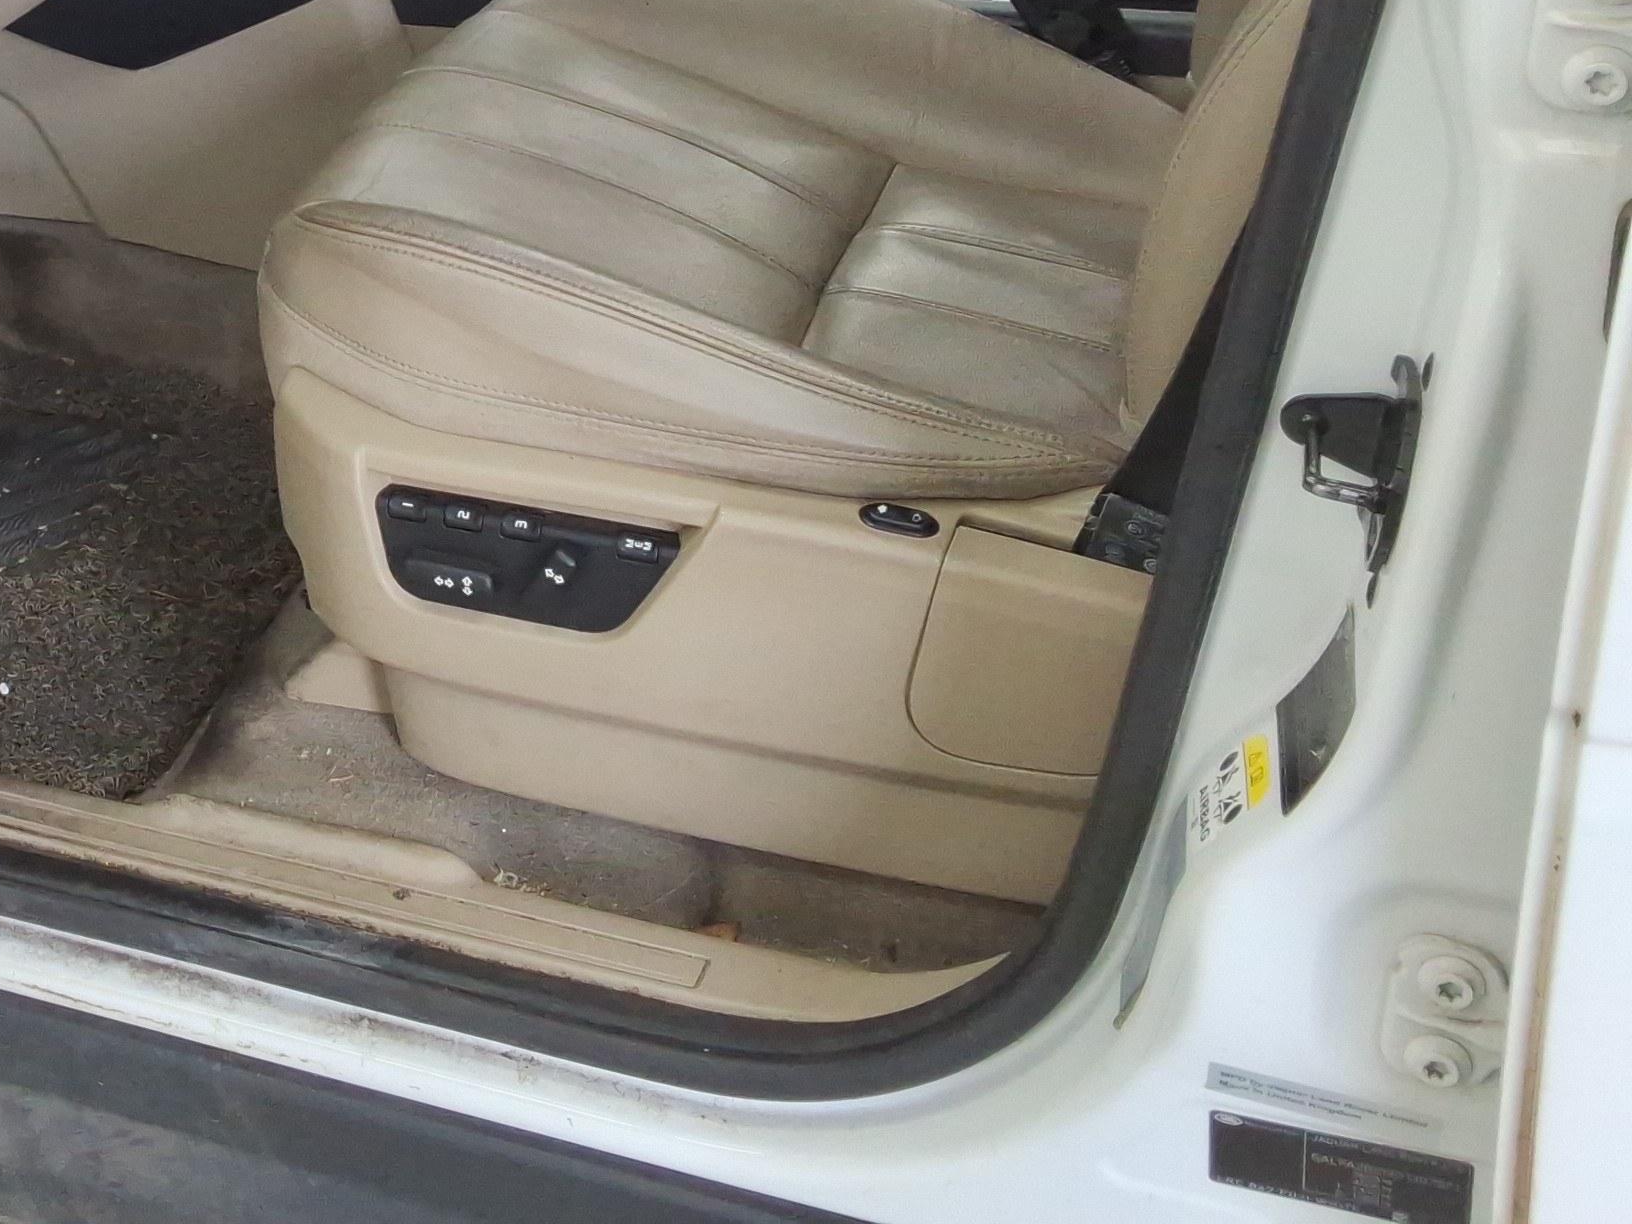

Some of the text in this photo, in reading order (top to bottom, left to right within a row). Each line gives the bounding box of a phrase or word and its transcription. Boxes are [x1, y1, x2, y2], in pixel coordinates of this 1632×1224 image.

[457, 510, 470, 520] 2
[514, 519, 528, 529] 3
[1199, 784, 1211, 842] AIRBAG
